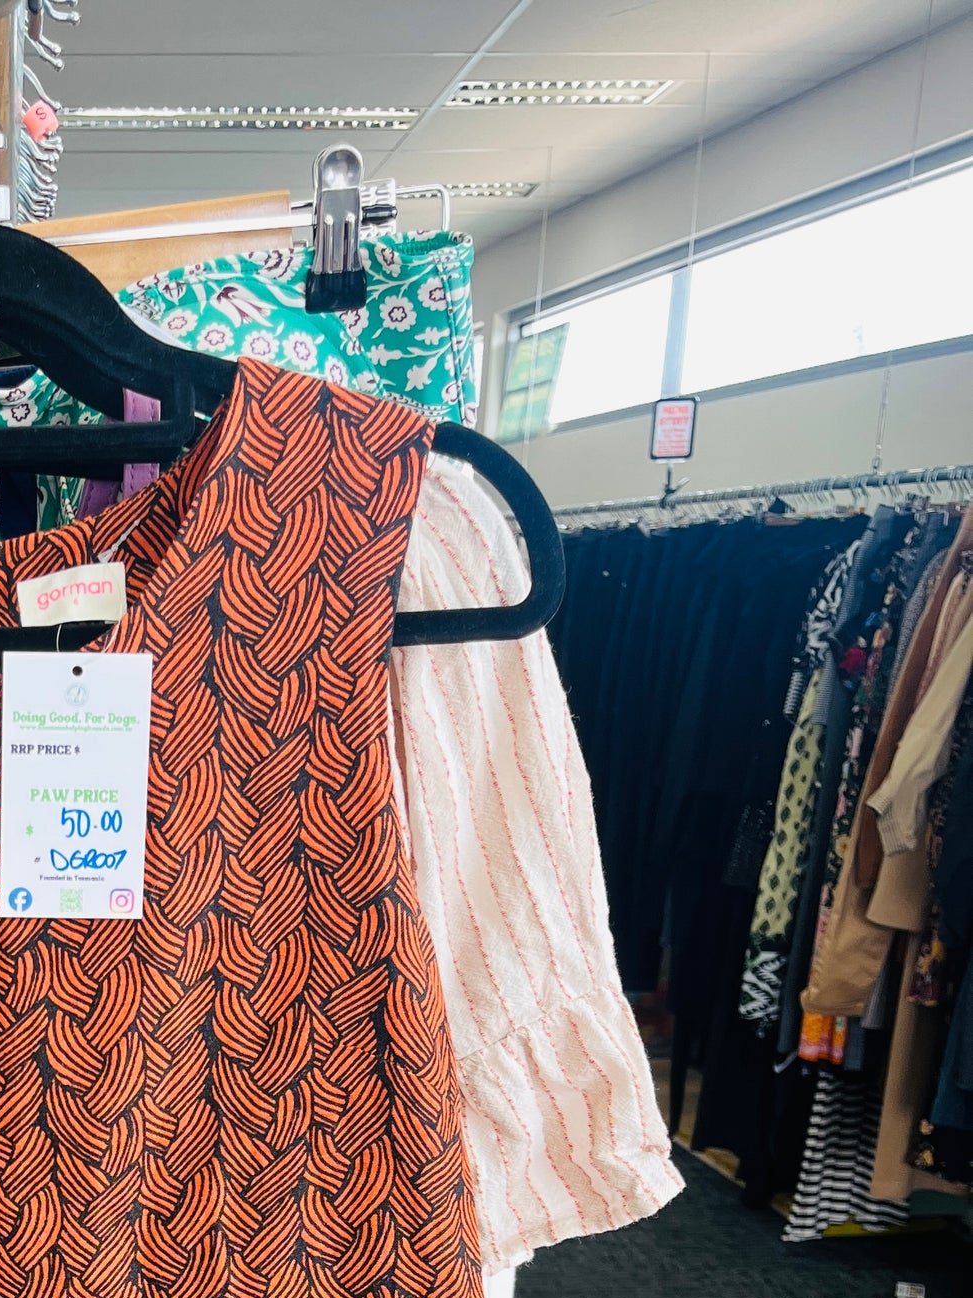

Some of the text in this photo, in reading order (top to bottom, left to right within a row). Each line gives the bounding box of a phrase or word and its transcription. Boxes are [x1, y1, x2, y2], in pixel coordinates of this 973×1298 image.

[35, 106, 47, 120] S
[37, 580, 113, 611] gorman
[12, 711, 140, 727] Doing Good. For Dogs.
[10, 744, 34, 755] RRP
[37, 744, 72, 755] PRICE
[30, 788, 119, 803] PAW PRICE
[25, 806, 123, 838] $ 50.00
